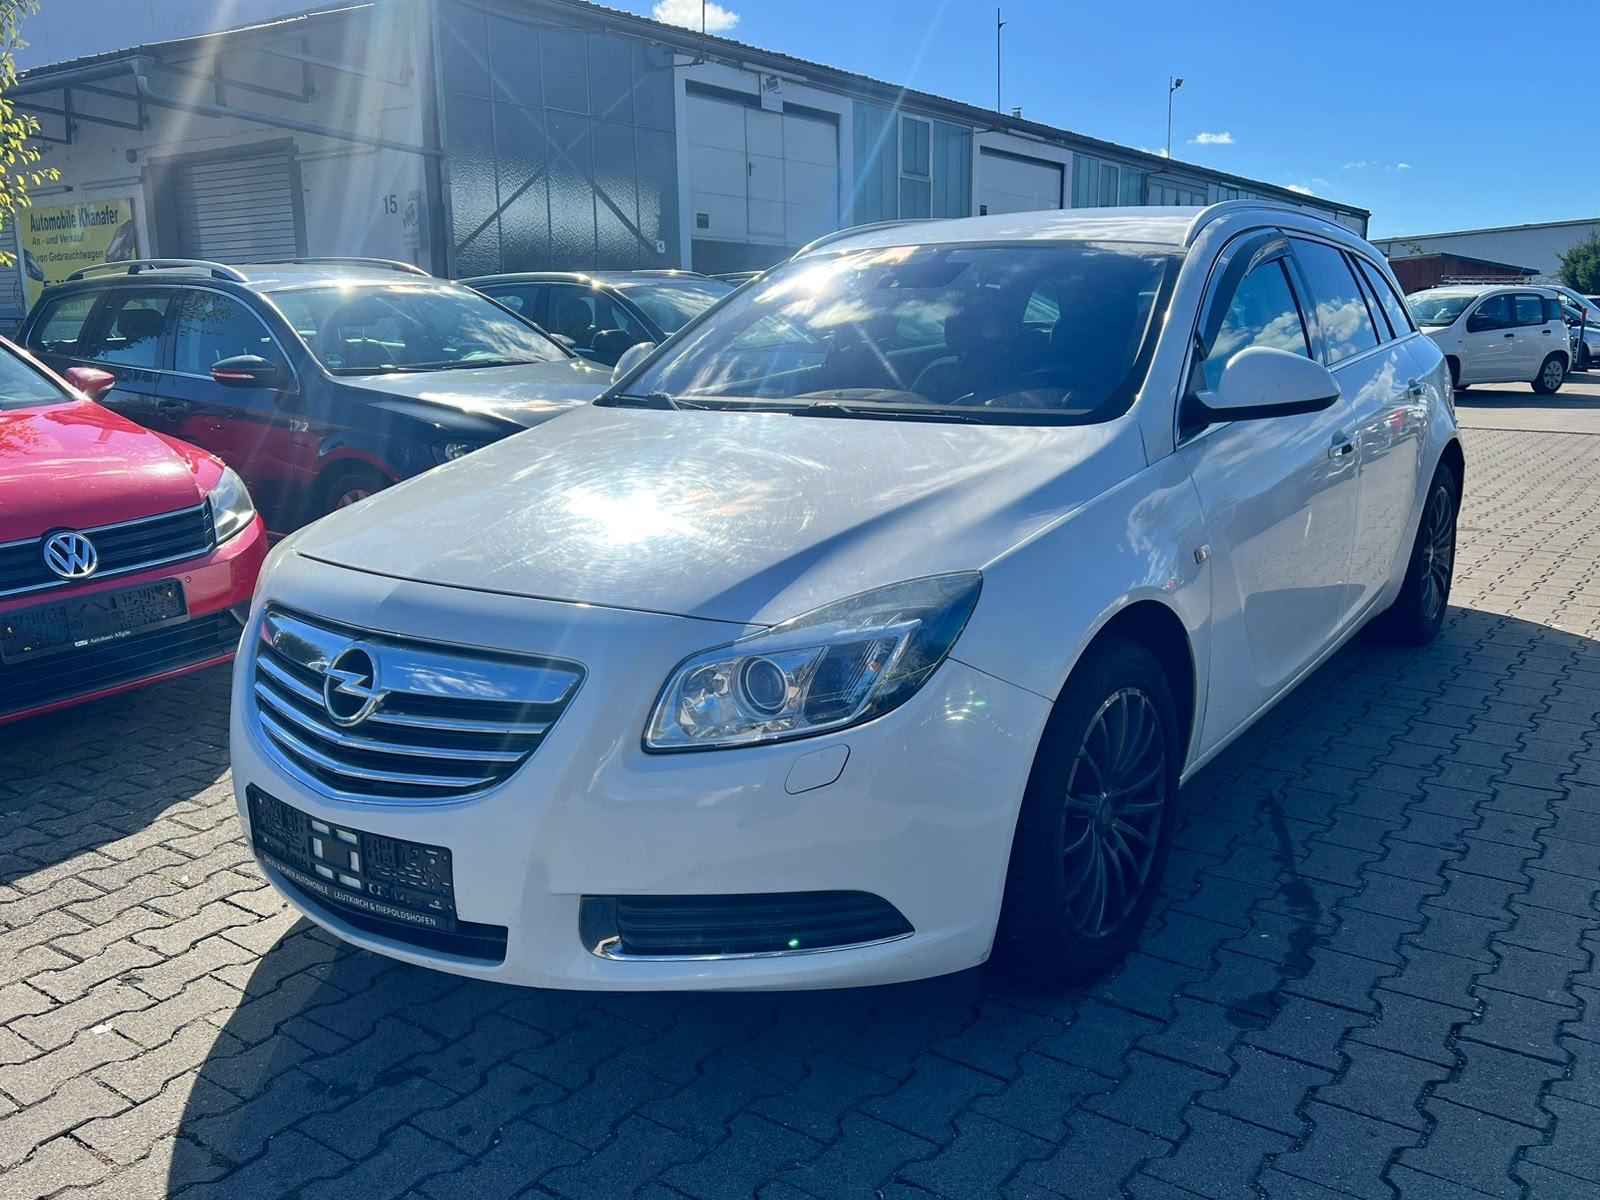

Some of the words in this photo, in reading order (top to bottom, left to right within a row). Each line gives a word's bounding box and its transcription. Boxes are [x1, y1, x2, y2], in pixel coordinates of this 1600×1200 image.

[382, 194, 398, 215] 15
[30, 210, 77, 233] Automobile
[79, 205, 120, 227] Khanafer
[46, 235, 58, 245] und
[37, 254, 48, 263] von
[48, 249, 104, 262] Gebrauchtwagen
[333, 890, 369, 909] LEUTKIRCH
[375, 904, 436, 926] DIEPOLDSHOFEN
